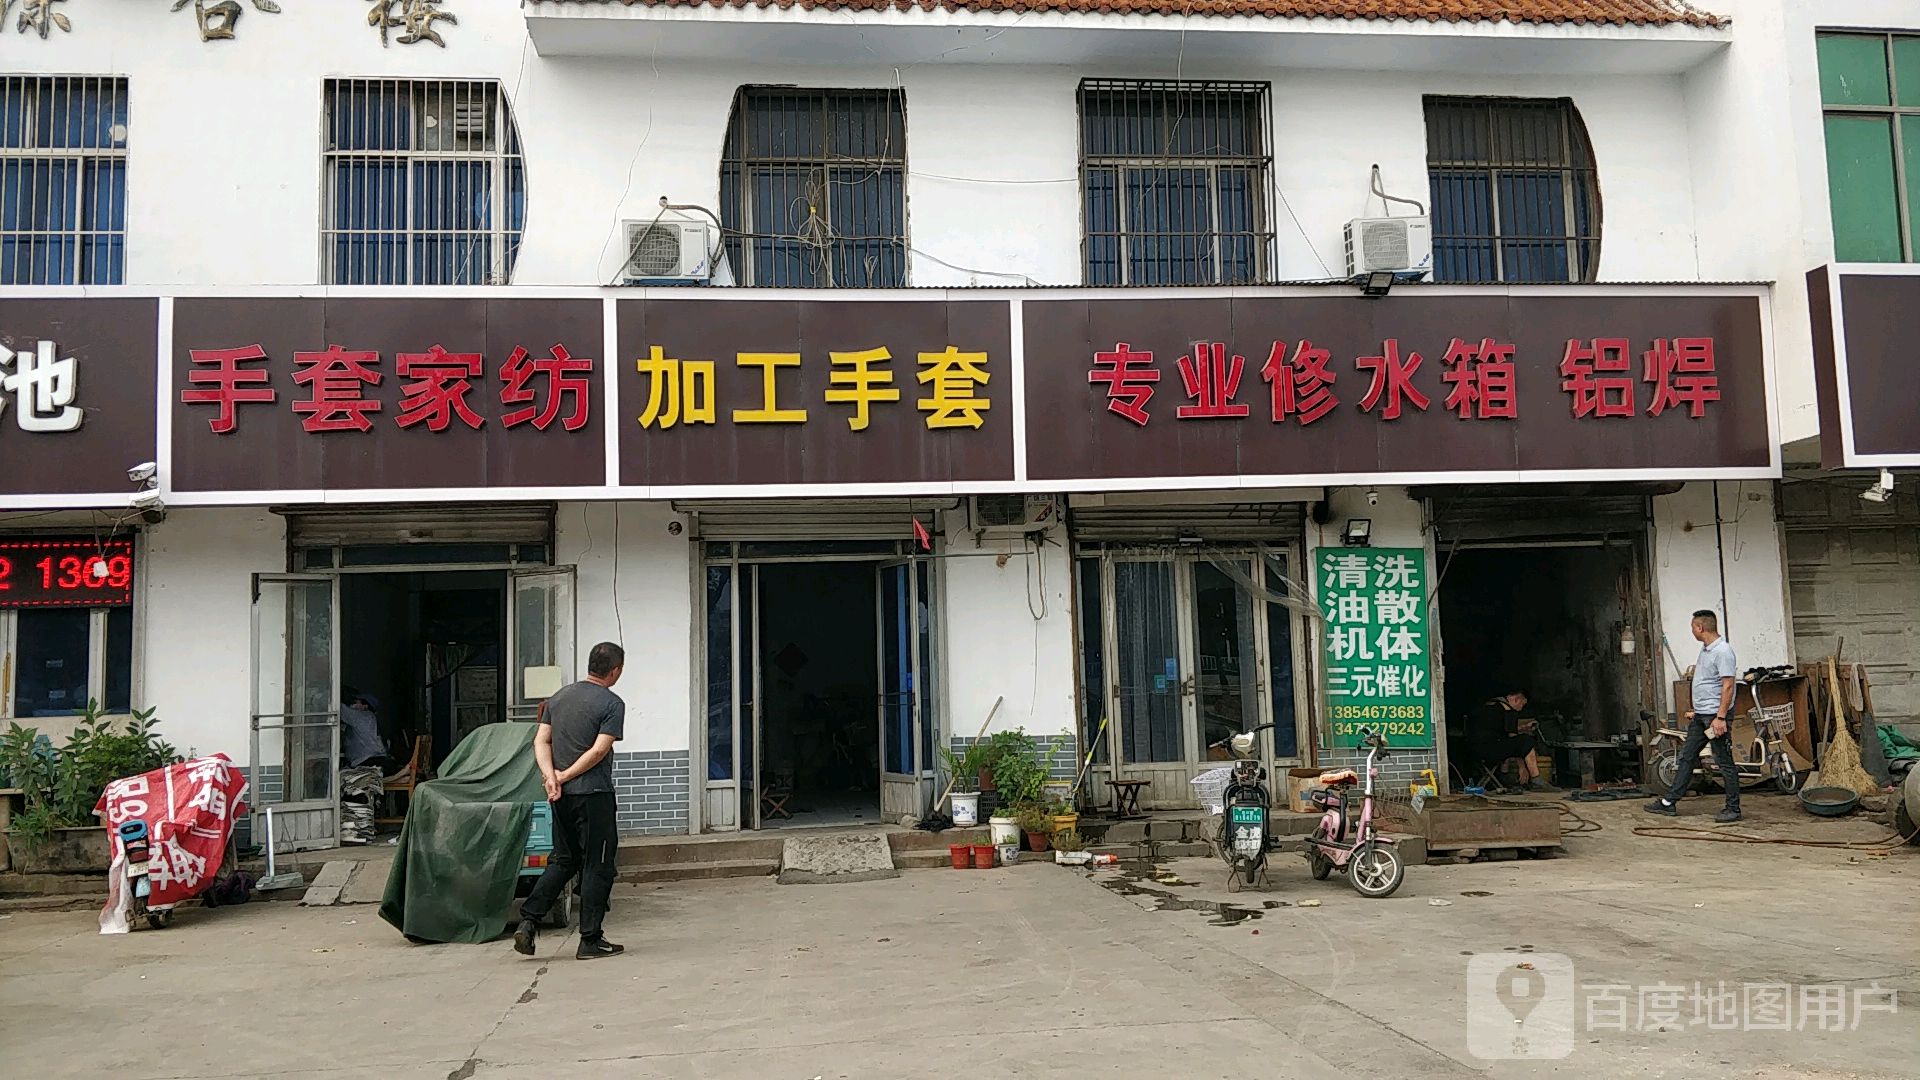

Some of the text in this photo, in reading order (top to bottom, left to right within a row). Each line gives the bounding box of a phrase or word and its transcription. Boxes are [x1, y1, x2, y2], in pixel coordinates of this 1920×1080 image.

[0, 340, 84, 433] 池
[180, 343, 593, 434] 手套家纺
[636, 345, 991, 431] 加工手套
[1087, 337, 1721, 427] 专业修水箱 铝焊
[1321, 553, 1420, 589] 清洗
[1324, 589, 1422, 625] 油散
[1326, 625, 1424, 661] 机体
[1325, 664, 1427, 699] 三元催化
[1327, 705, 1425, 719] 13854673683
